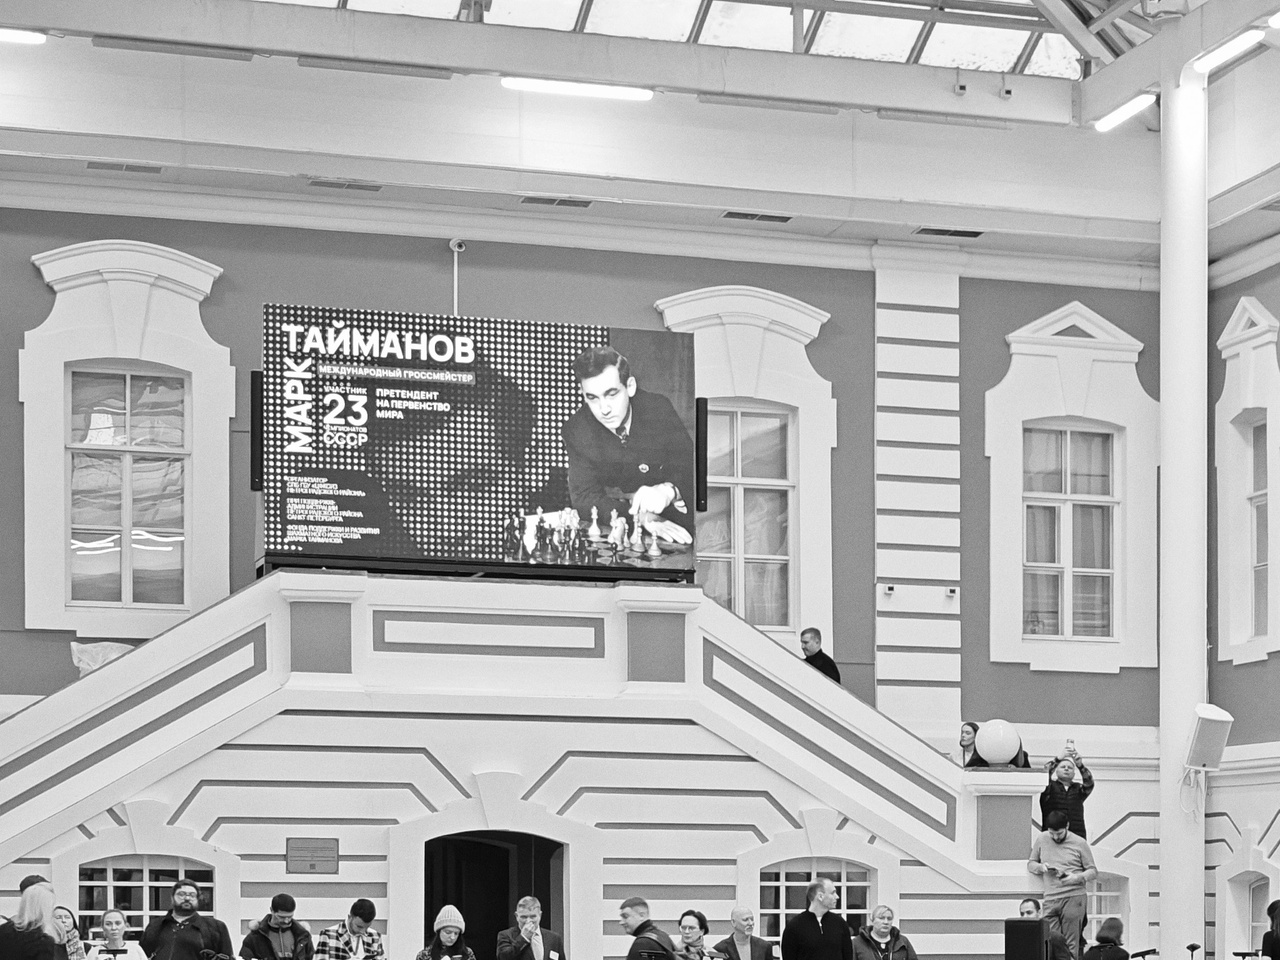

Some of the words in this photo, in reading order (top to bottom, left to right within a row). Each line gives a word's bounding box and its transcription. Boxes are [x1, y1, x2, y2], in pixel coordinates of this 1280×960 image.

[281, 320, 475, 364] ТАЙМАНОВ
[318, 365, 402, 379] МЕЖДУНАРОДНЫЙ
[403, 369, 474, 383] ГРОССМЕЙСТЕР
[323, 385, 368, 395] УЧАСТНИК
[375, 388, 440, 400] ПРЕТЕНДЕНТ
[283, 356, 313, 454] МАРК
[323, 393, 369, 426] 23
[376, 399, 390, 409] НА
[391, 400, 451, 412] ПЕРВЕНСТВО
[376, 410, 404, 420] МИРА
[323, 432, 369, 446] СССР
